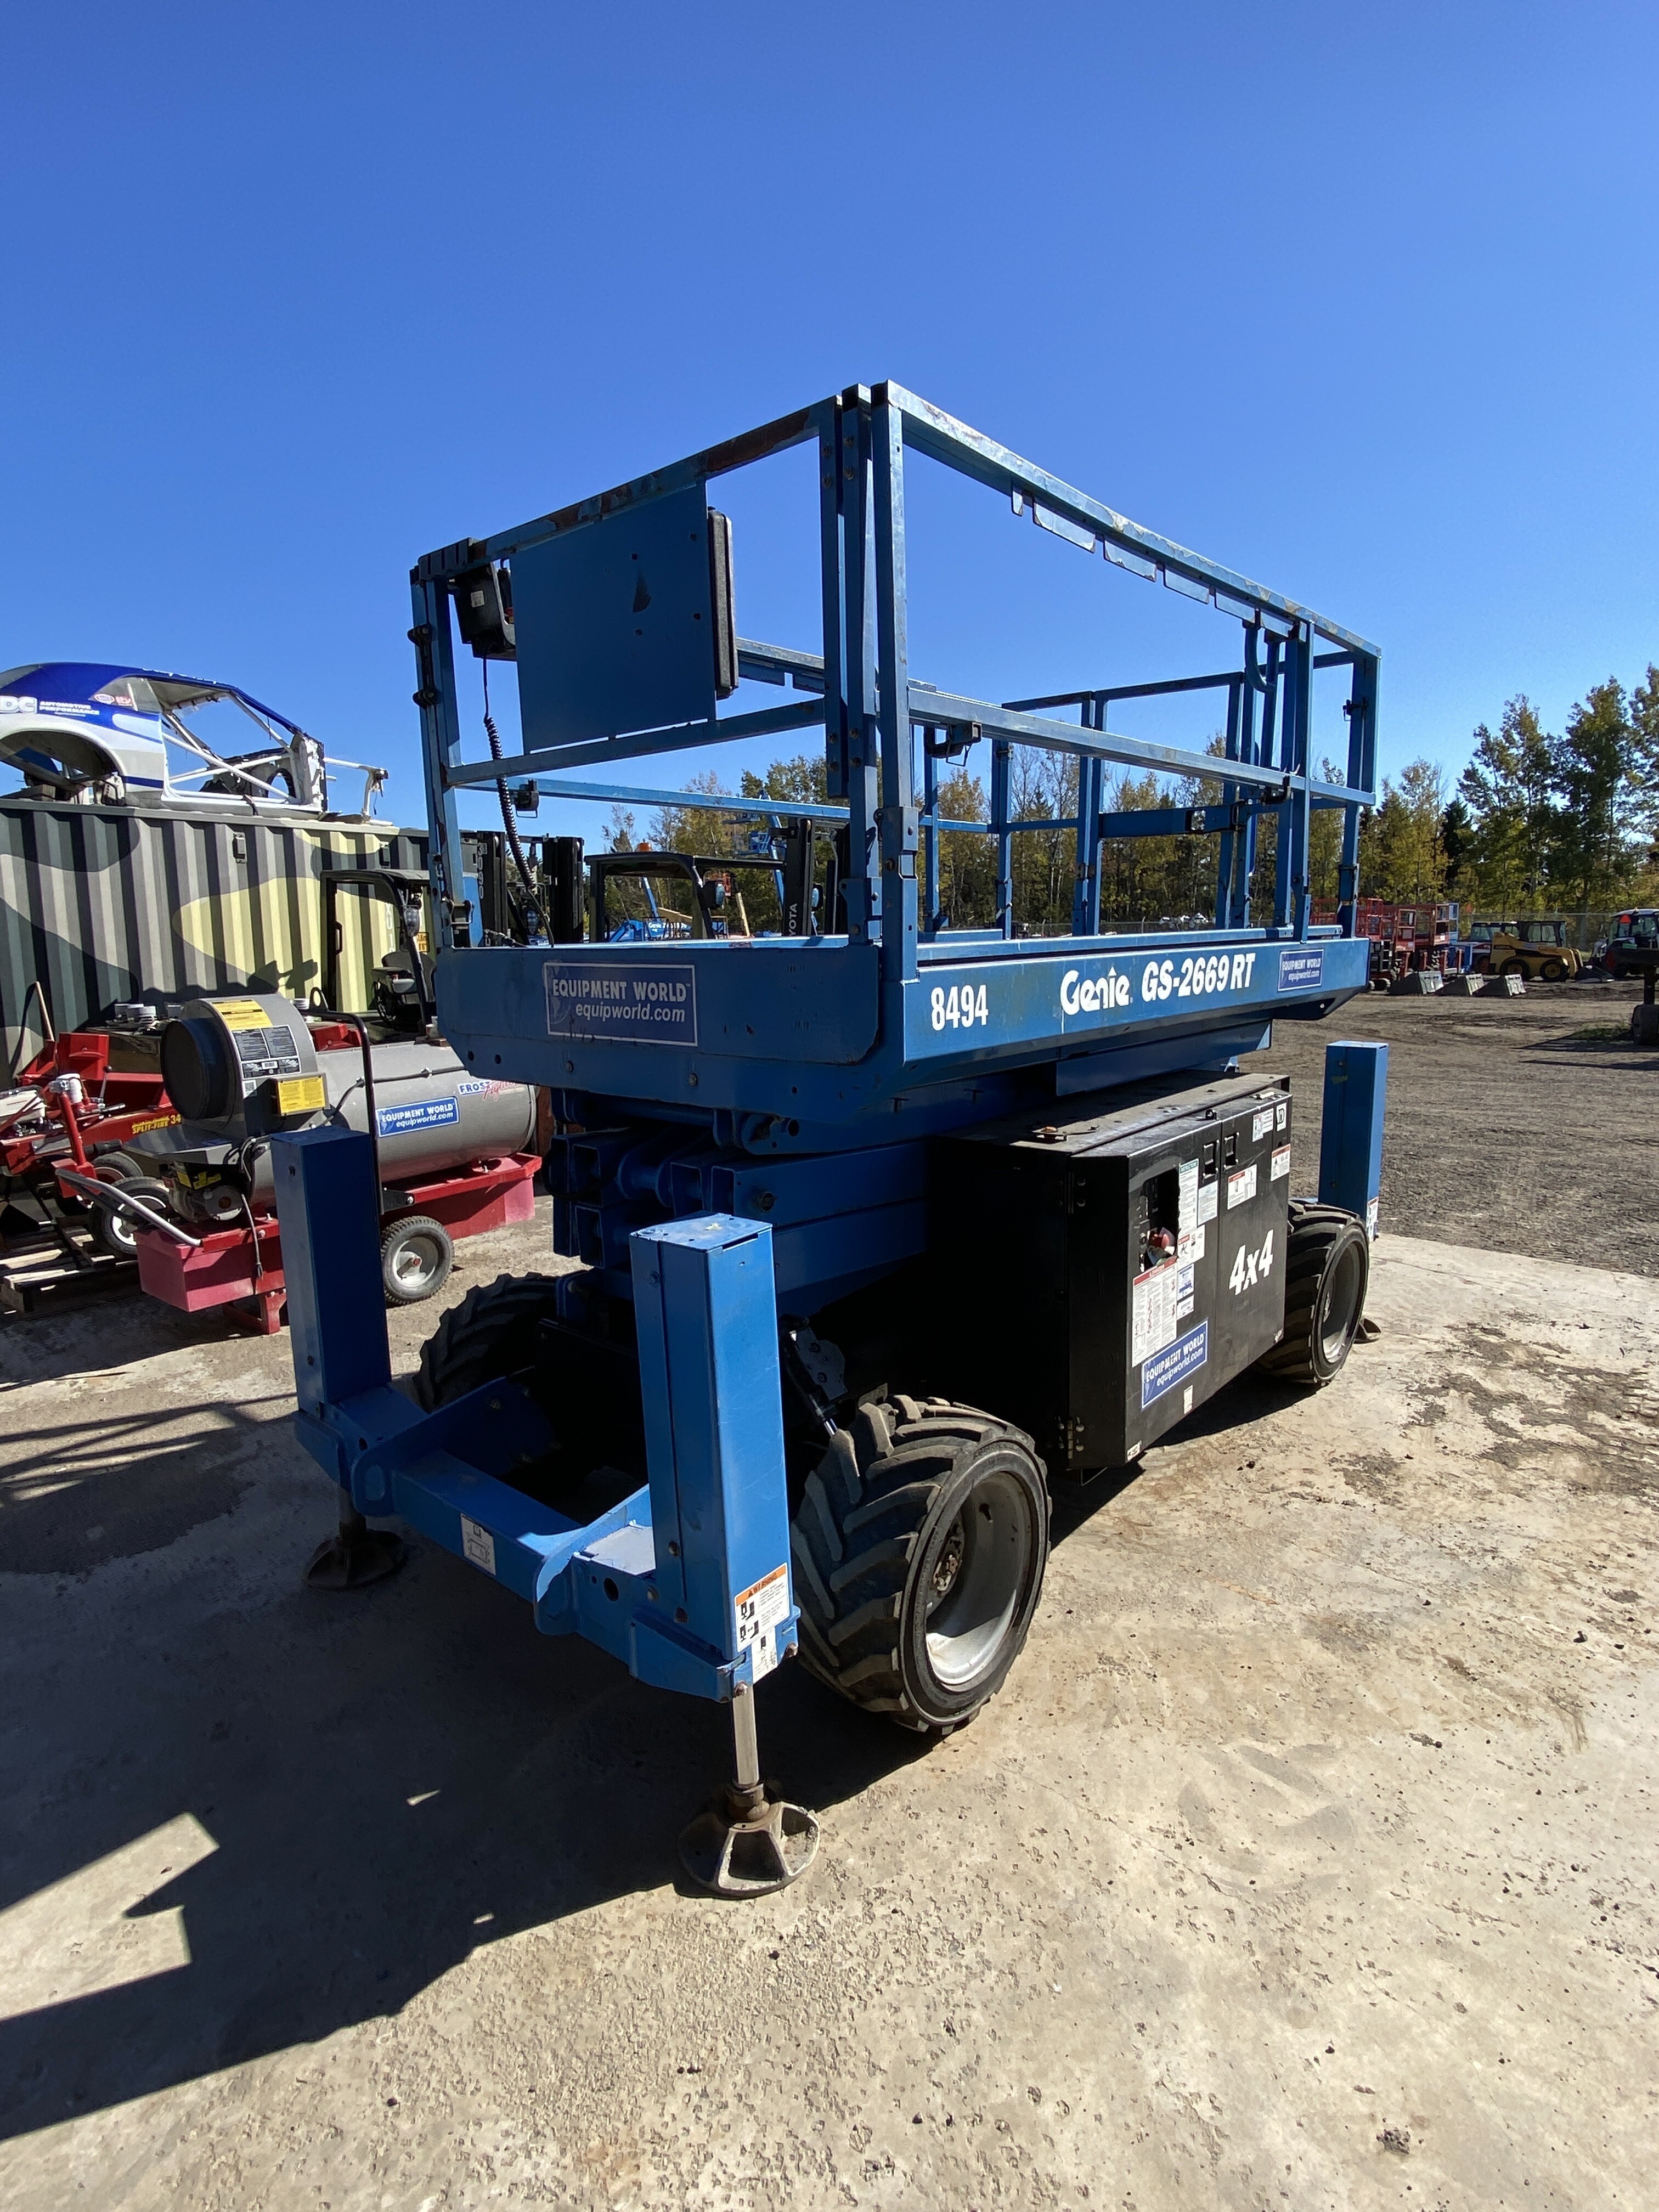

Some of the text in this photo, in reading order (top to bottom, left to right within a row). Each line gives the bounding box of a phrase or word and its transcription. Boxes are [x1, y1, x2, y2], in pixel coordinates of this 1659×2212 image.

[1282, 959, 1306, 970] EQUIPMENT
[552, 979, 627, 1000] EQUIPMENT
[932, 953, 1256, 1031] 8494 Genie GS-2669 RT
[576, 1001, 685, 1022] equipworld.com
[170, 1114, 181, 1124] 34
[381, 1108, 424, 1122] EQUIPMENT
[396, 1111, 453, 1127] equipworld.com
[1229, 1229, 1273, 1295] 4x4
[1146, 1348, 1181, 1383] EQUIPMENT
[1156, 1347, 1203, 1387] equipworld.com
